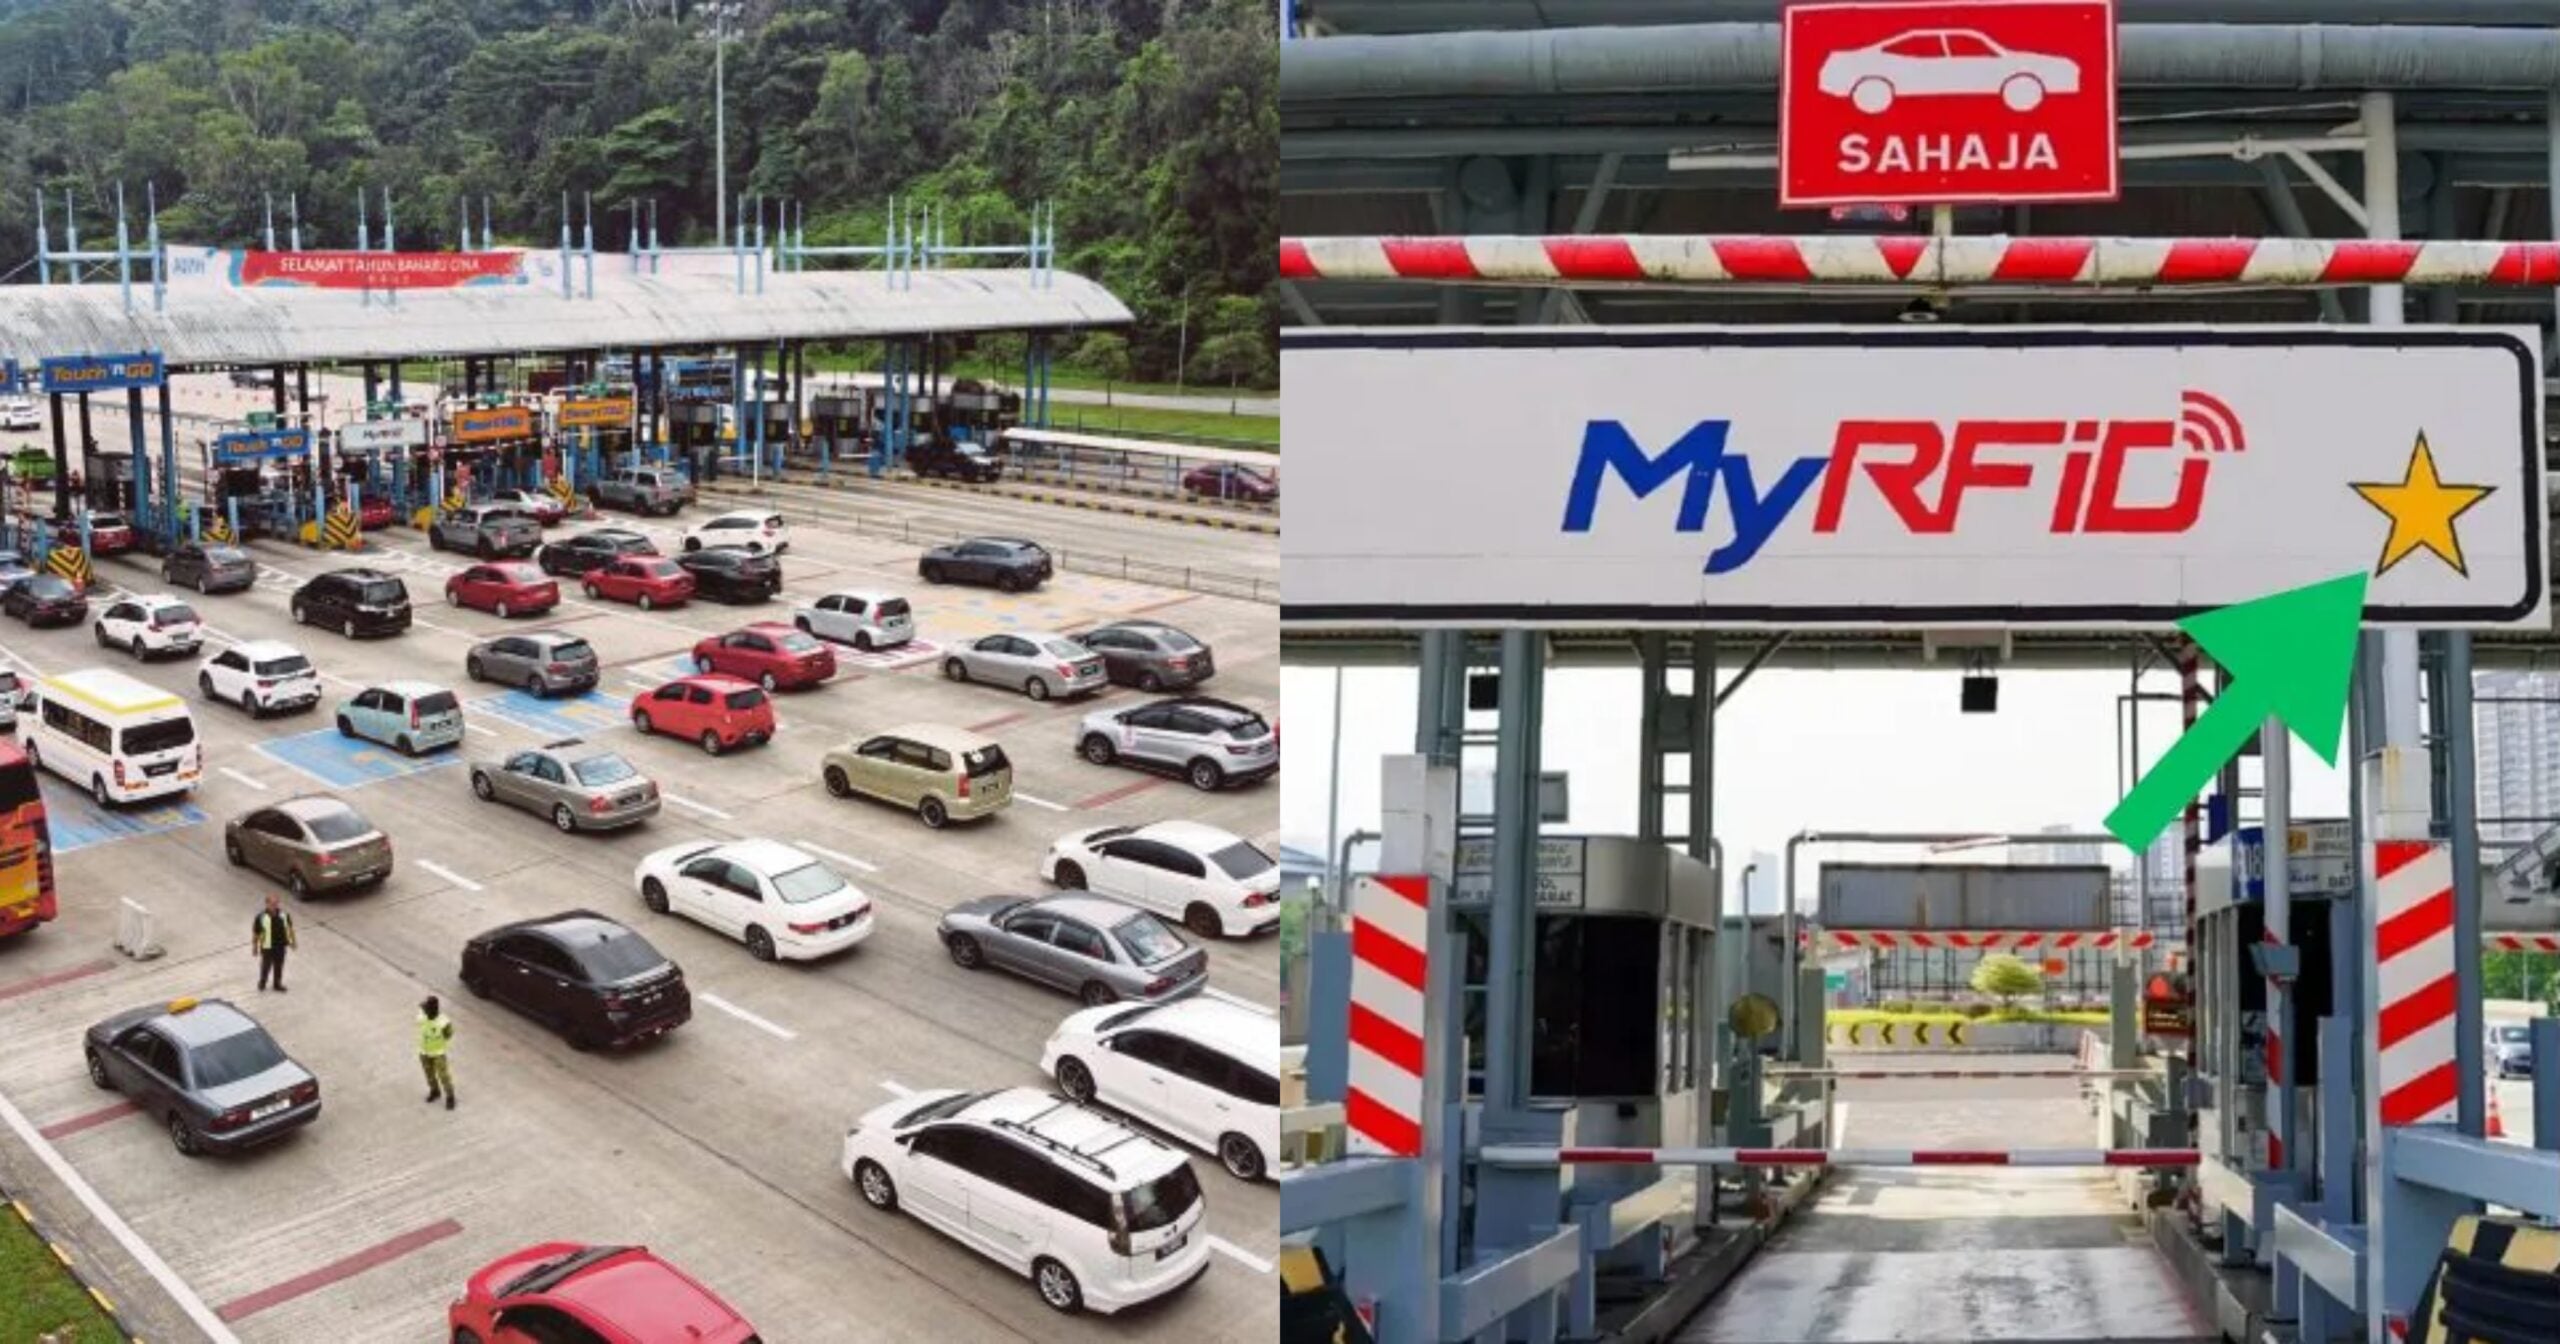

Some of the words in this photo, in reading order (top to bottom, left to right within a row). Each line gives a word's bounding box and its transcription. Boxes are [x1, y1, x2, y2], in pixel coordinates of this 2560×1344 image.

[1837, 132, 2059, 173] SAHAJA
[280, 257, 344, 273] SELAMAT
[53, 366, 107, 382] Touch
